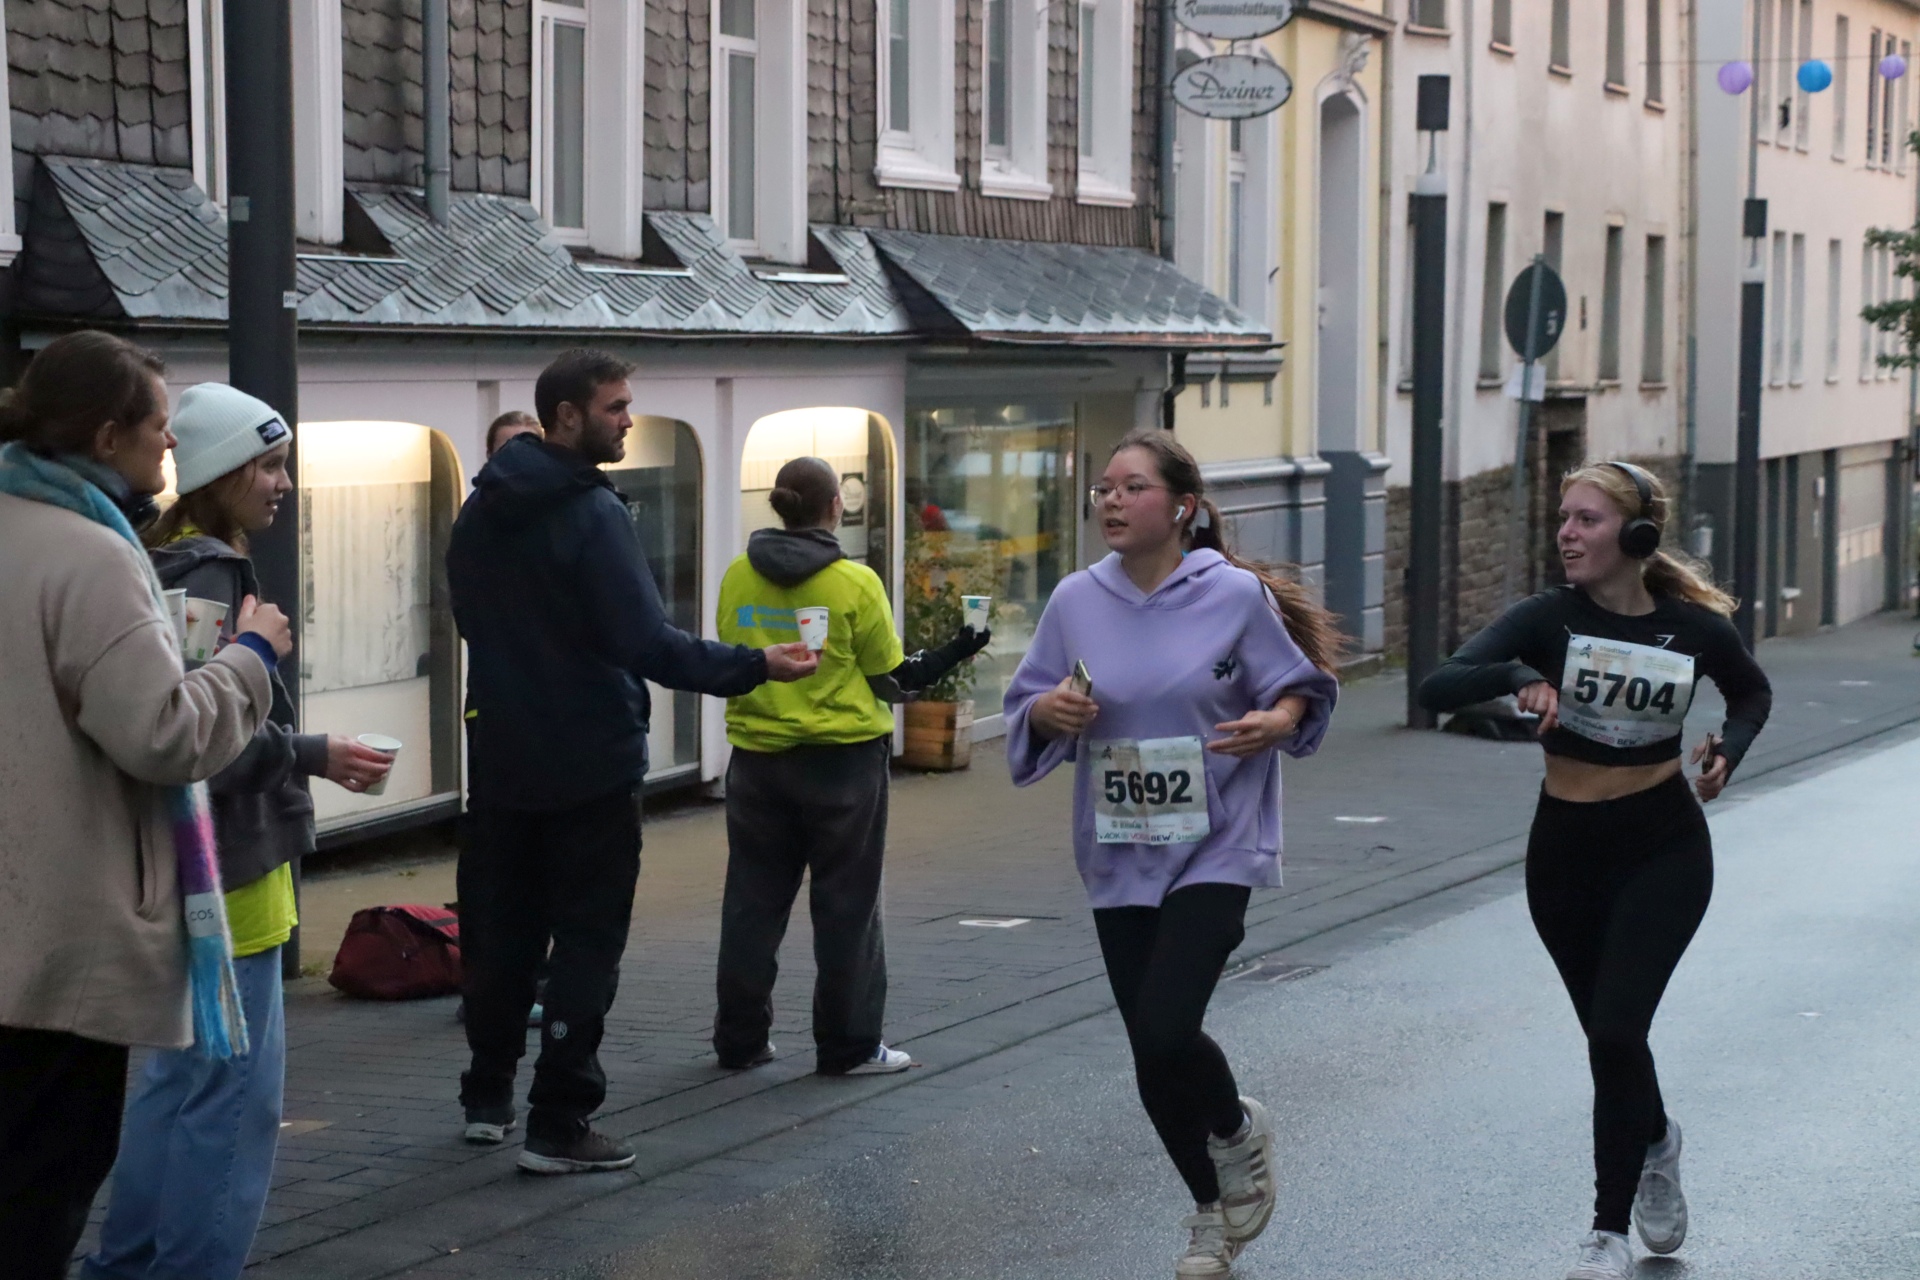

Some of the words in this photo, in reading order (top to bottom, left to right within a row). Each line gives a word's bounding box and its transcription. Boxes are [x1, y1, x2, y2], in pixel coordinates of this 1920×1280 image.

[1187, 71, 1275, 100] Dreiner
[1574, 668, 1676, 715] 5704
[1104, 769, 1193, 806] 5692
[190, 908, 214, 921] COS
